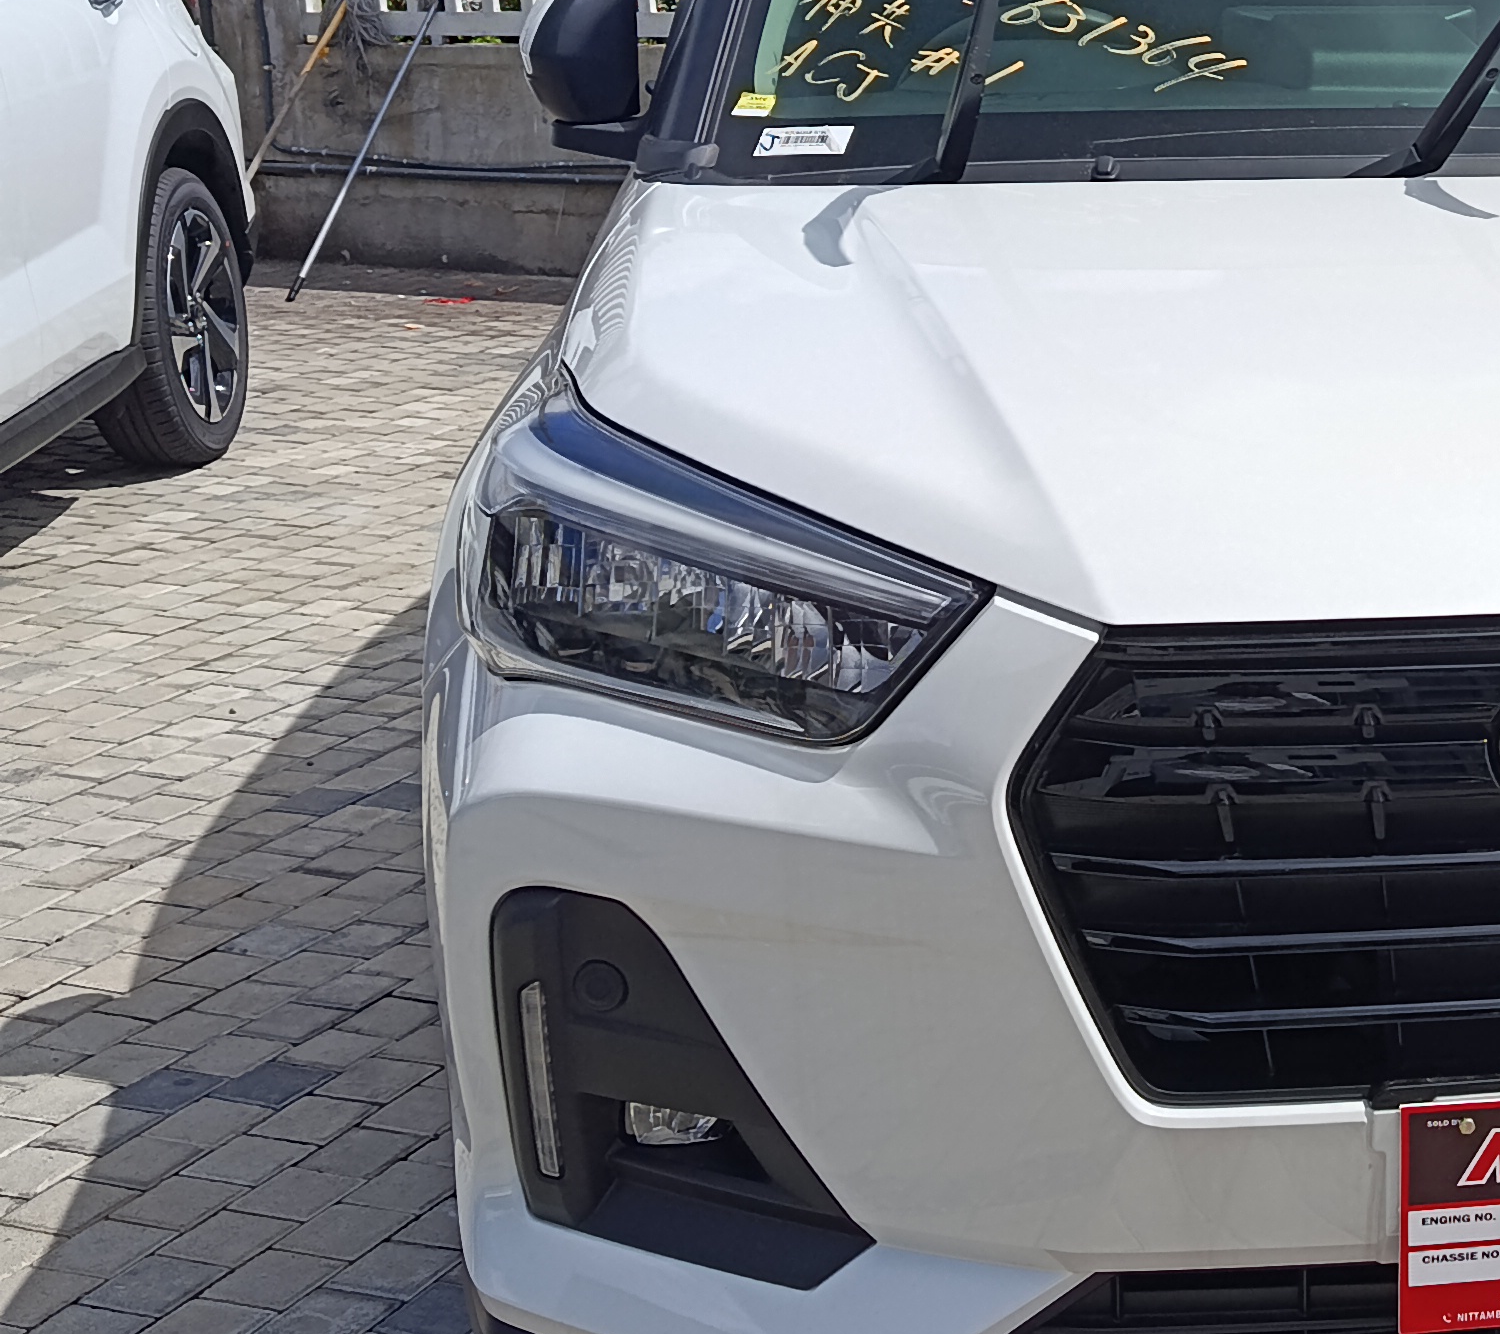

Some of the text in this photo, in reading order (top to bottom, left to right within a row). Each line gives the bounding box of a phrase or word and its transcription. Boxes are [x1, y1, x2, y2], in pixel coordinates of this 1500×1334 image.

[1427, 1119, 1450, 1128] SOLD
[1474, 1212, 1496, 1222] NO.
[1422, 1251, 1478, 1264] CHASSIE
